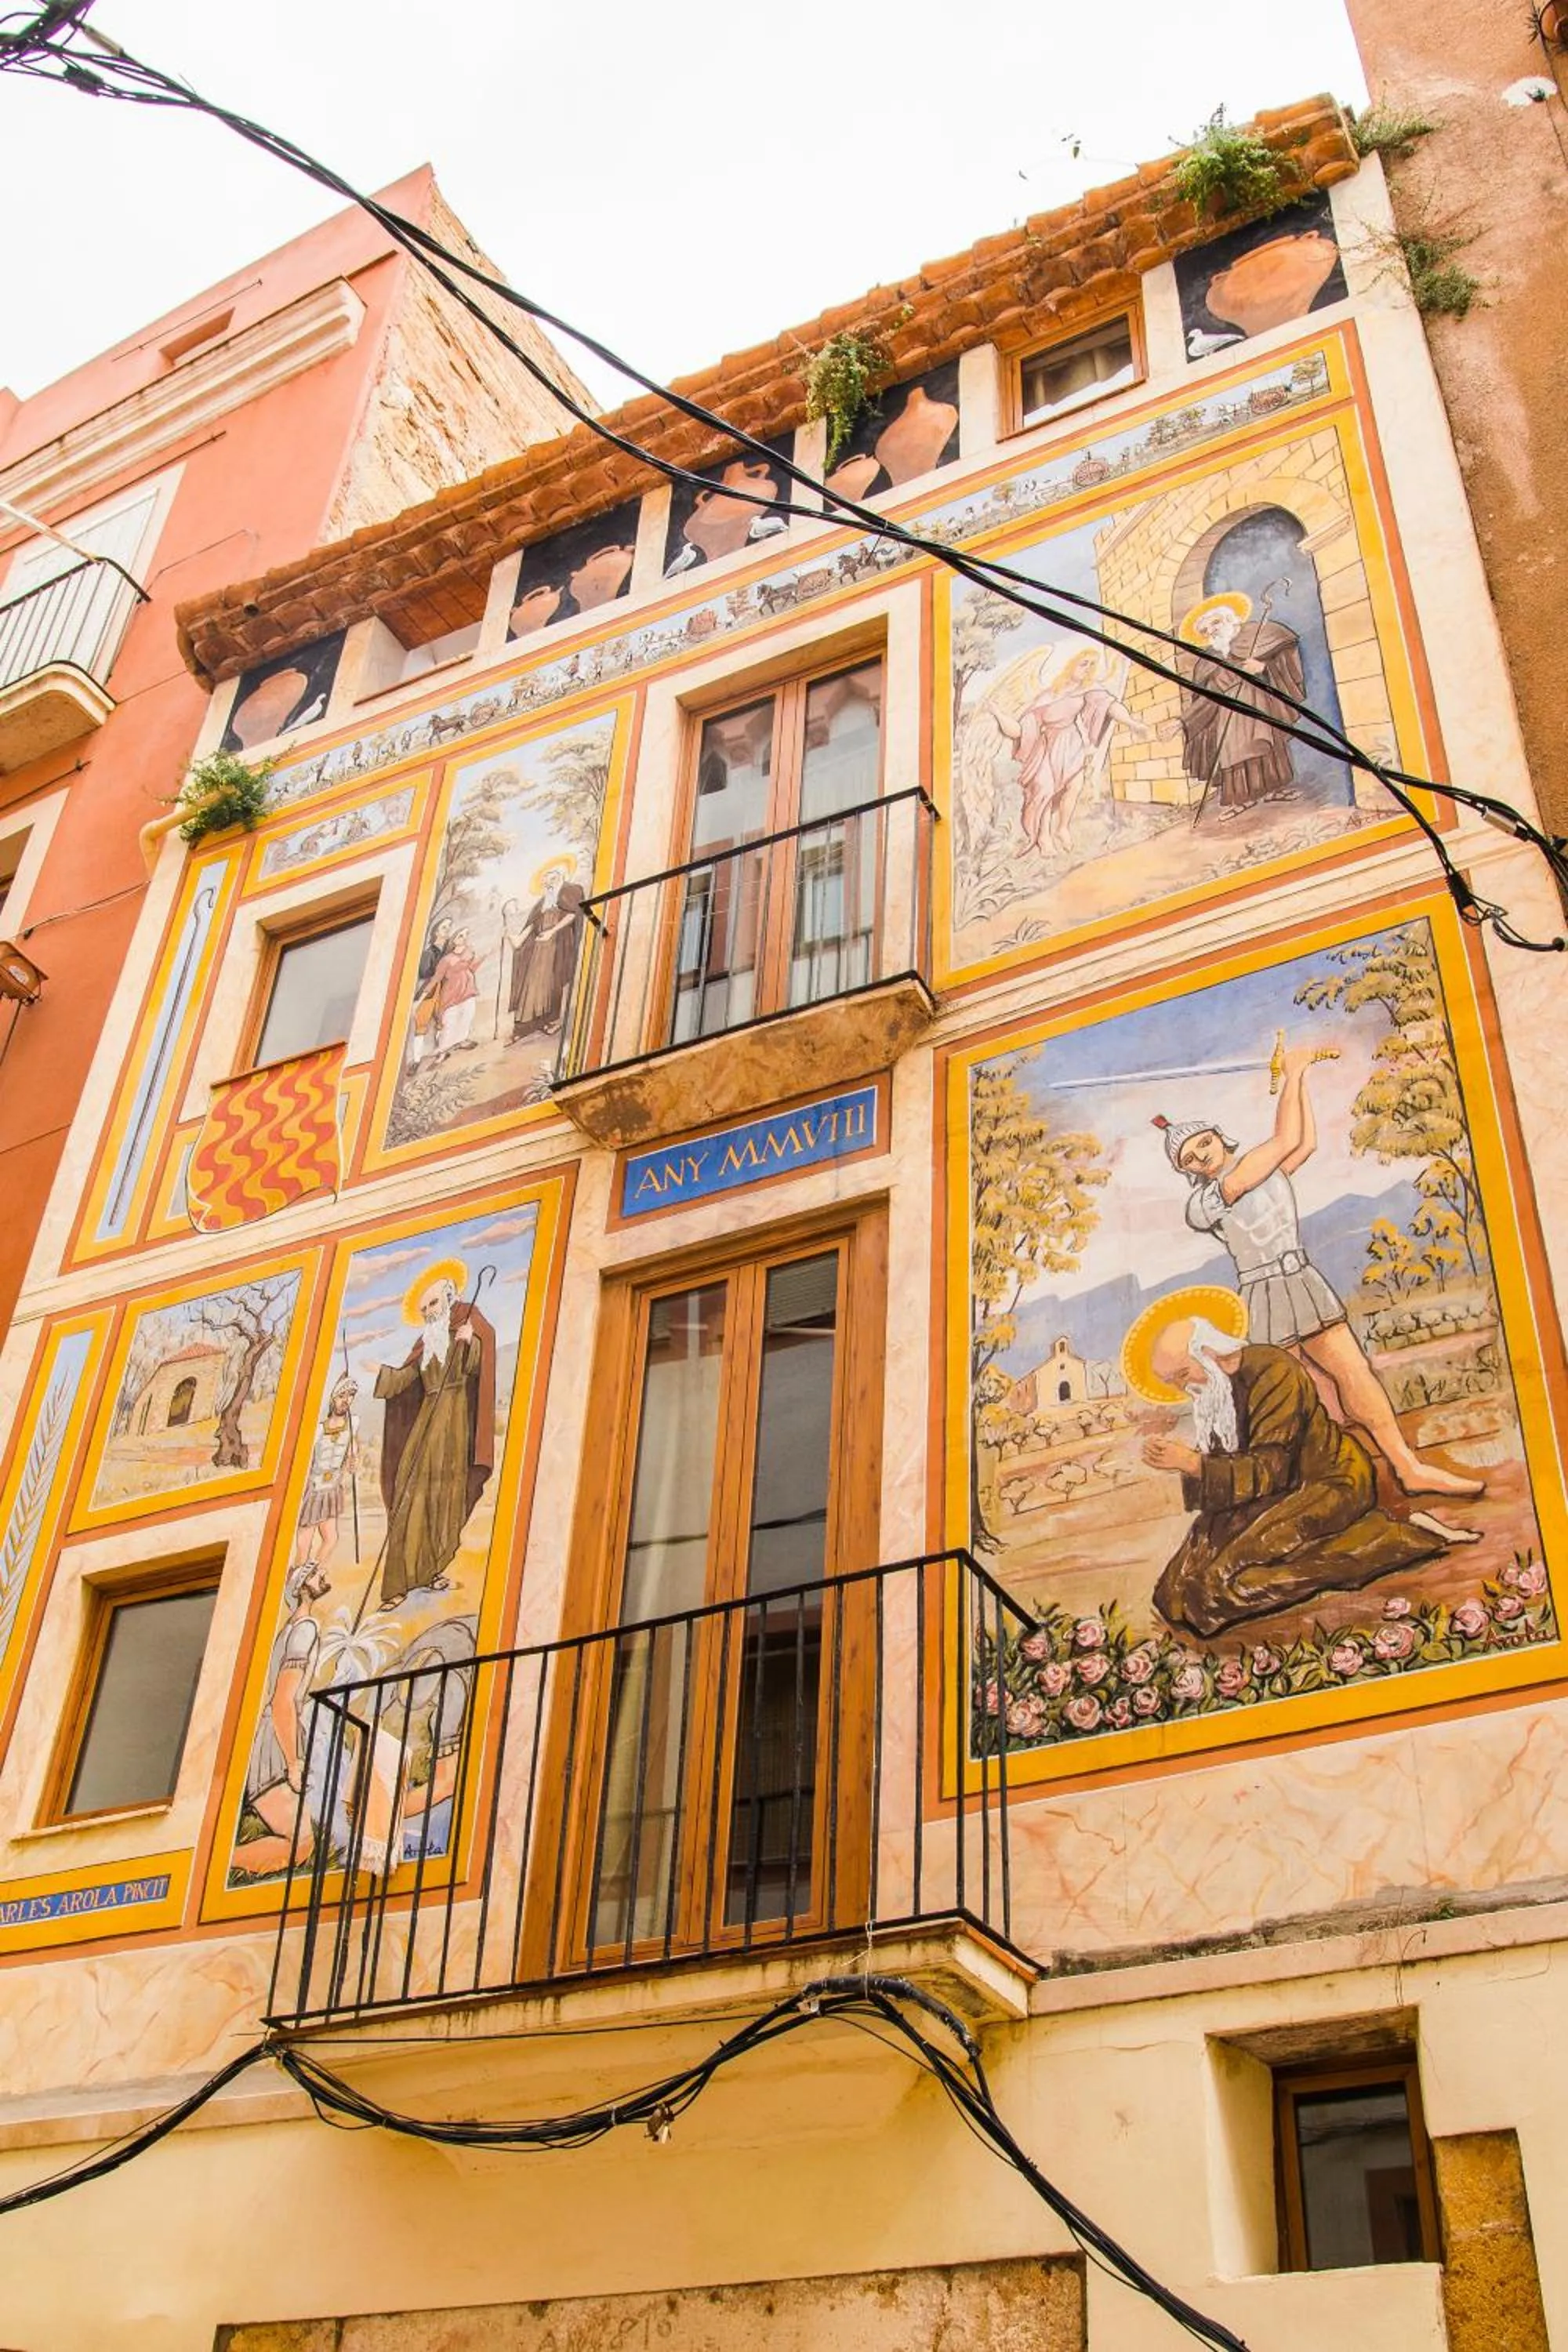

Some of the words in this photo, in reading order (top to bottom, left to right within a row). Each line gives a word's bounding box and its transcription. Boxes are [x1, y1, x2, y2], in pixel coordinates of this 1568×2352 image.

[634, 1152, 710, 1199] ANY
[717, 1103, 866, 1177] MMVIII
[1480, 1617, 1556, 1653] Arola
[56, 1886, 118, 1914] AROLA
